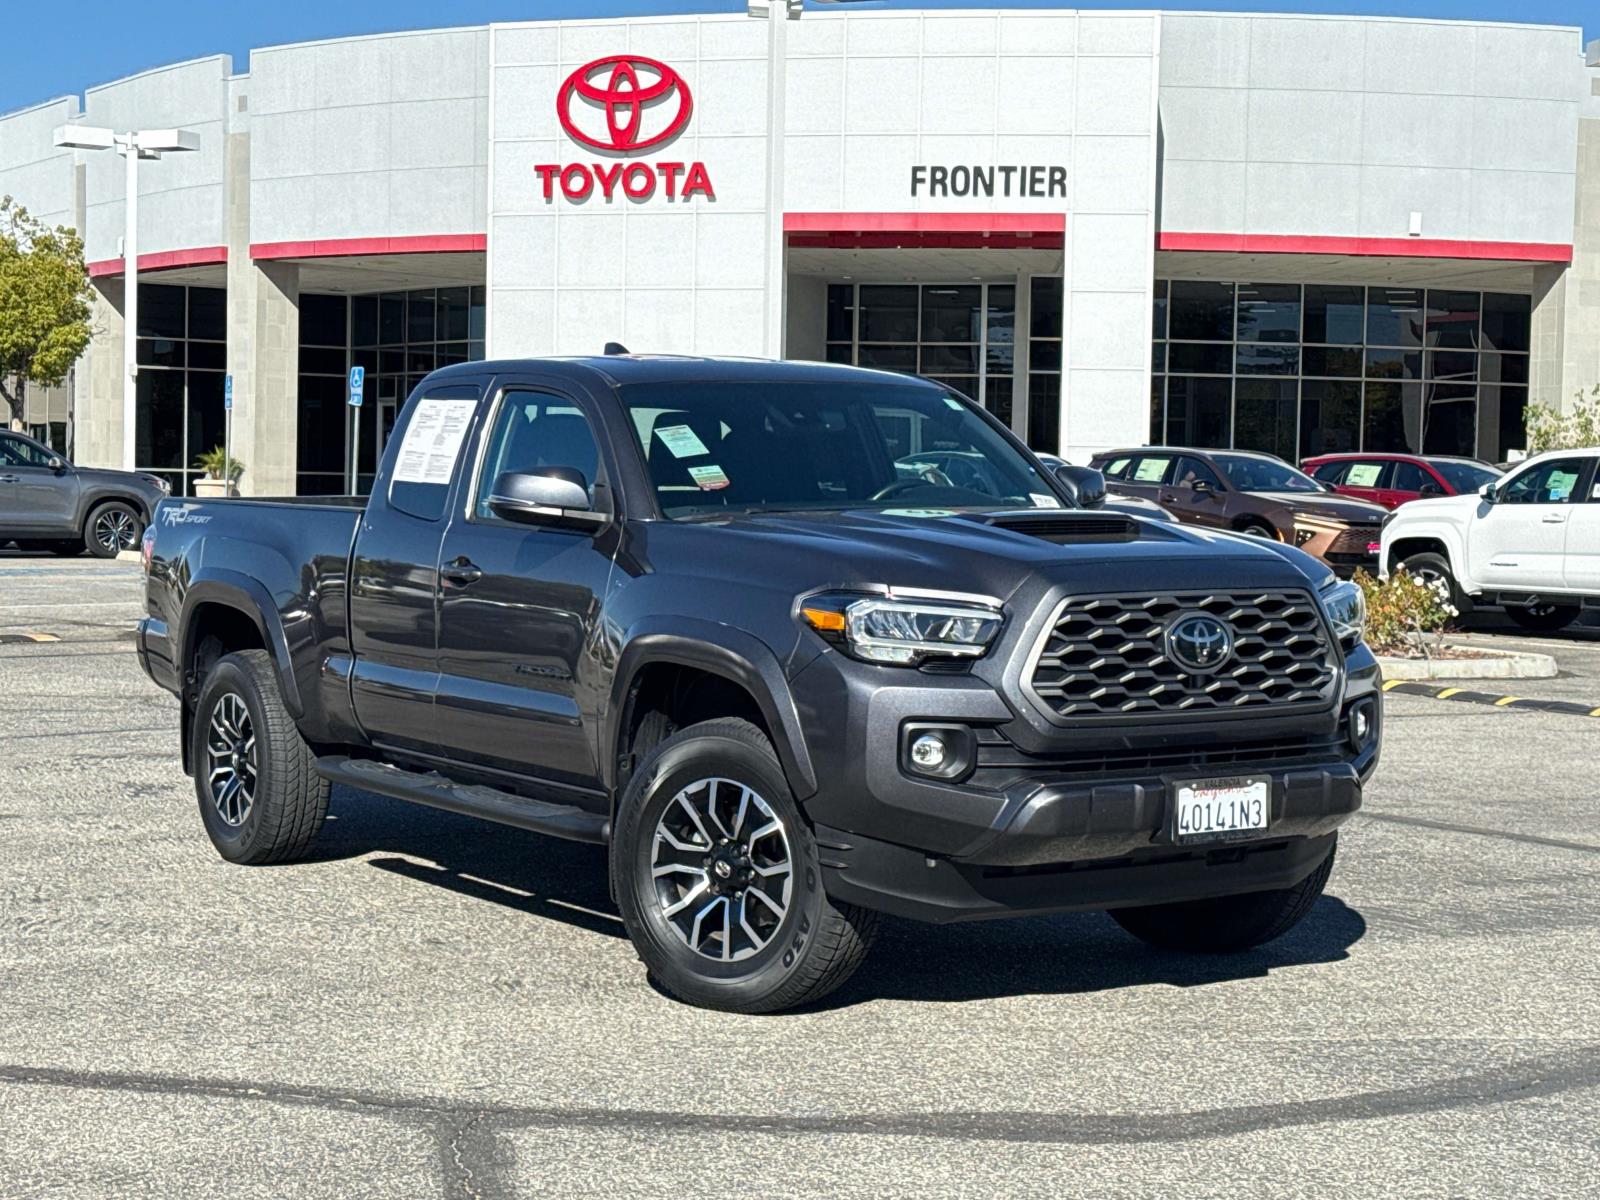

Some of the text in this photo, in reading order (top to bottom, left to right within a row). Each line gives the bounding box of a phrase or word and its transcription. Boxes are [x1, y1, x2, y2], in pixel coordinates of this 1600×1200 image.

[534, 162, 715, 202] TOYOTA
[911, 165, 1067, 197] FRONTIER
[161, 506, 213, 528] TRD SPORT
[1179, 799, 1262, 832] 40141N3
